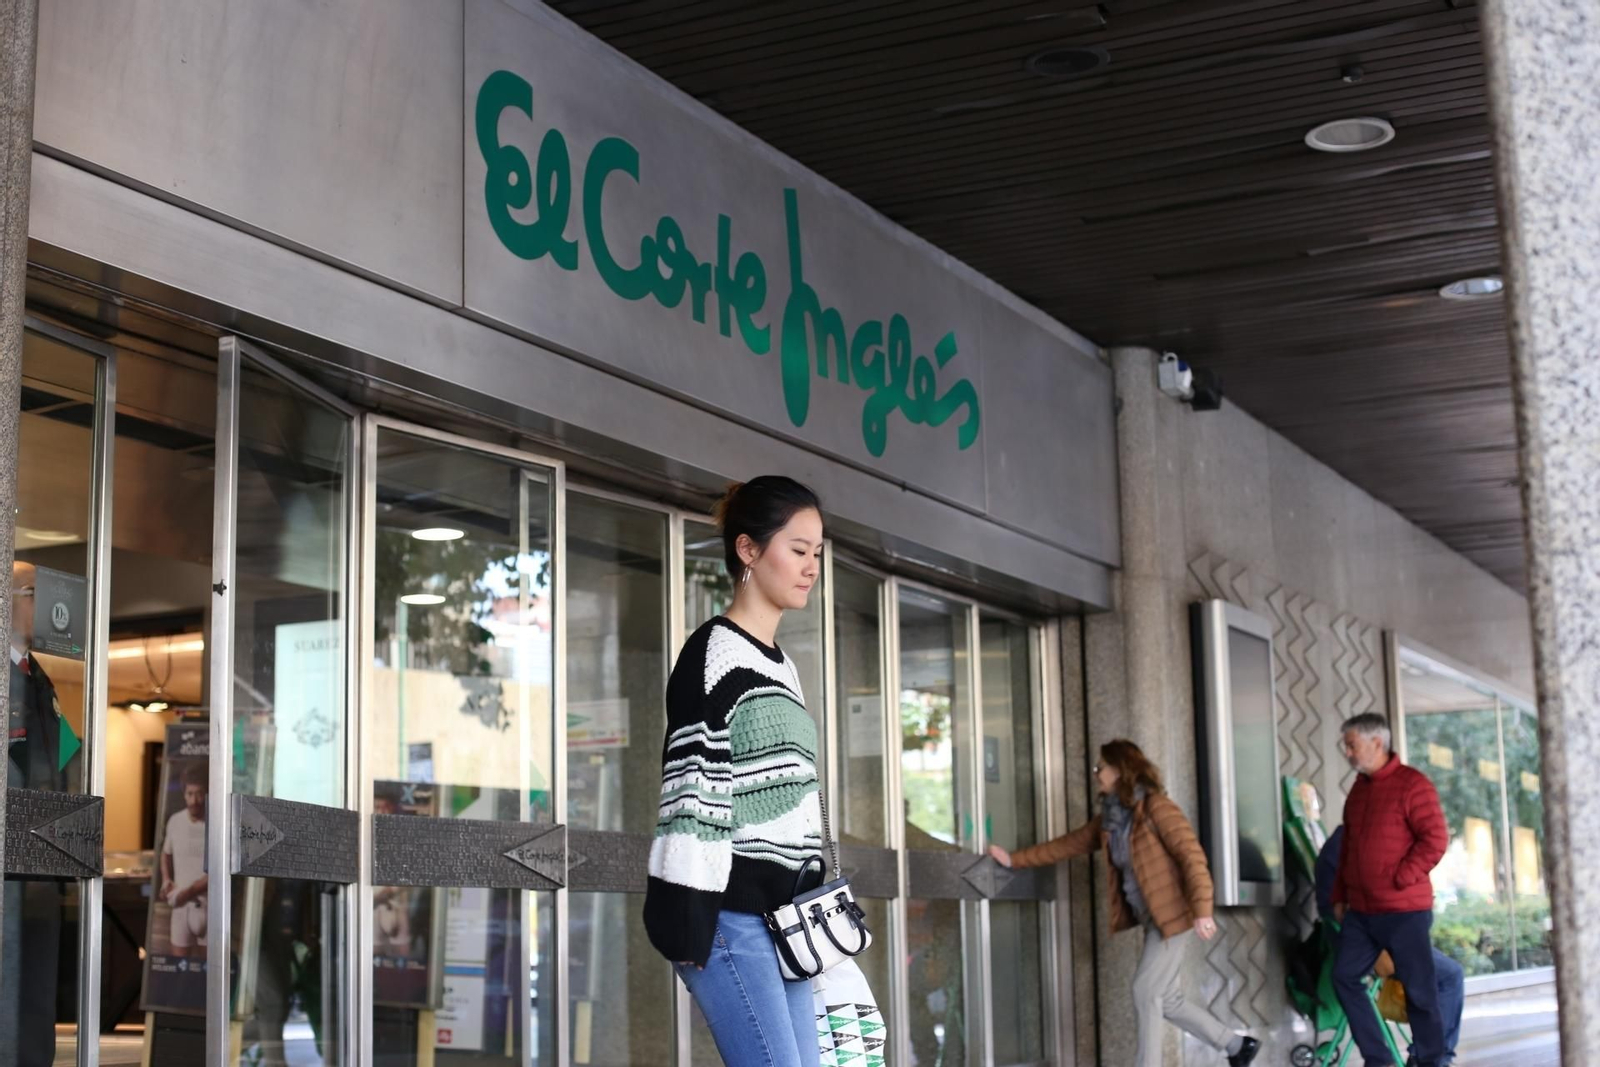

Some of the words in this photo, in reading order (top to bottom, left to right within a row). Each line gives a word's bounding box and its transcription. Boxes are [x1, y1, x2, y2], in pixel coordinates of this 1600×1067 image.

[475, 69, 578, 271] El
[583, 137, 771, 355] Corte
[780, 187, 981, 458] Inglés
